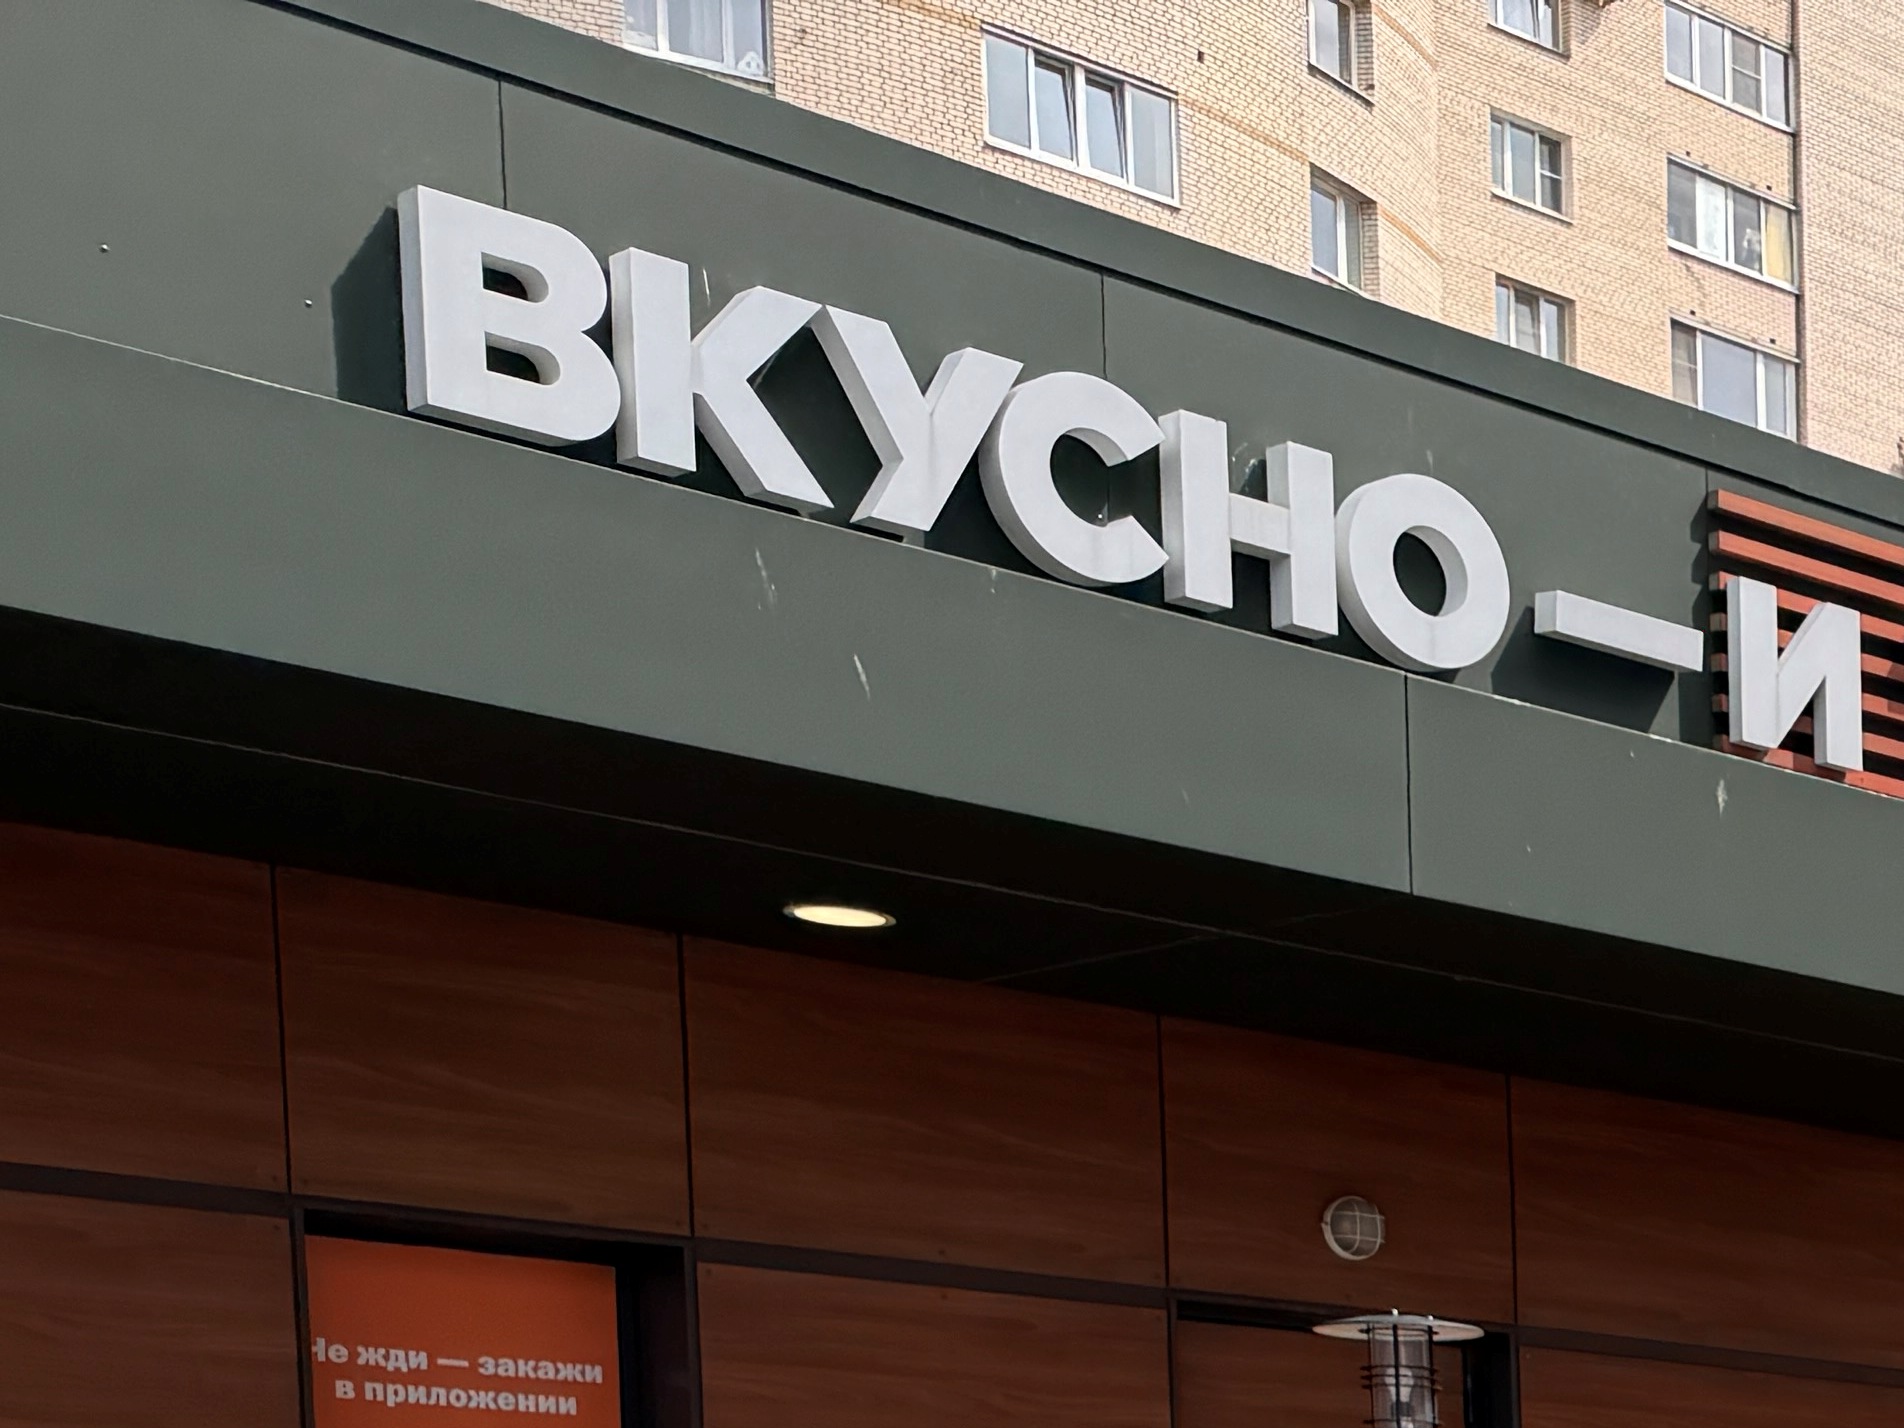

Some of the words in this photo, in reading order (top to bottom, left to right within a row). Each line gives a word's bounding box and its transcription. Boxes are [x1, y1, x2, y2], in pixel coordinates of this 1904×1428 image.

[398, 183, 1511, 673] ВКУСНО
[1725, 575, 1863, 773] И
[356, 1345, 429, 1373] жди
[477, 1355, 604, 1384] закажи
[335, 1379, 356, 1400] в
[364, 1380, 578, 1416] приложении
